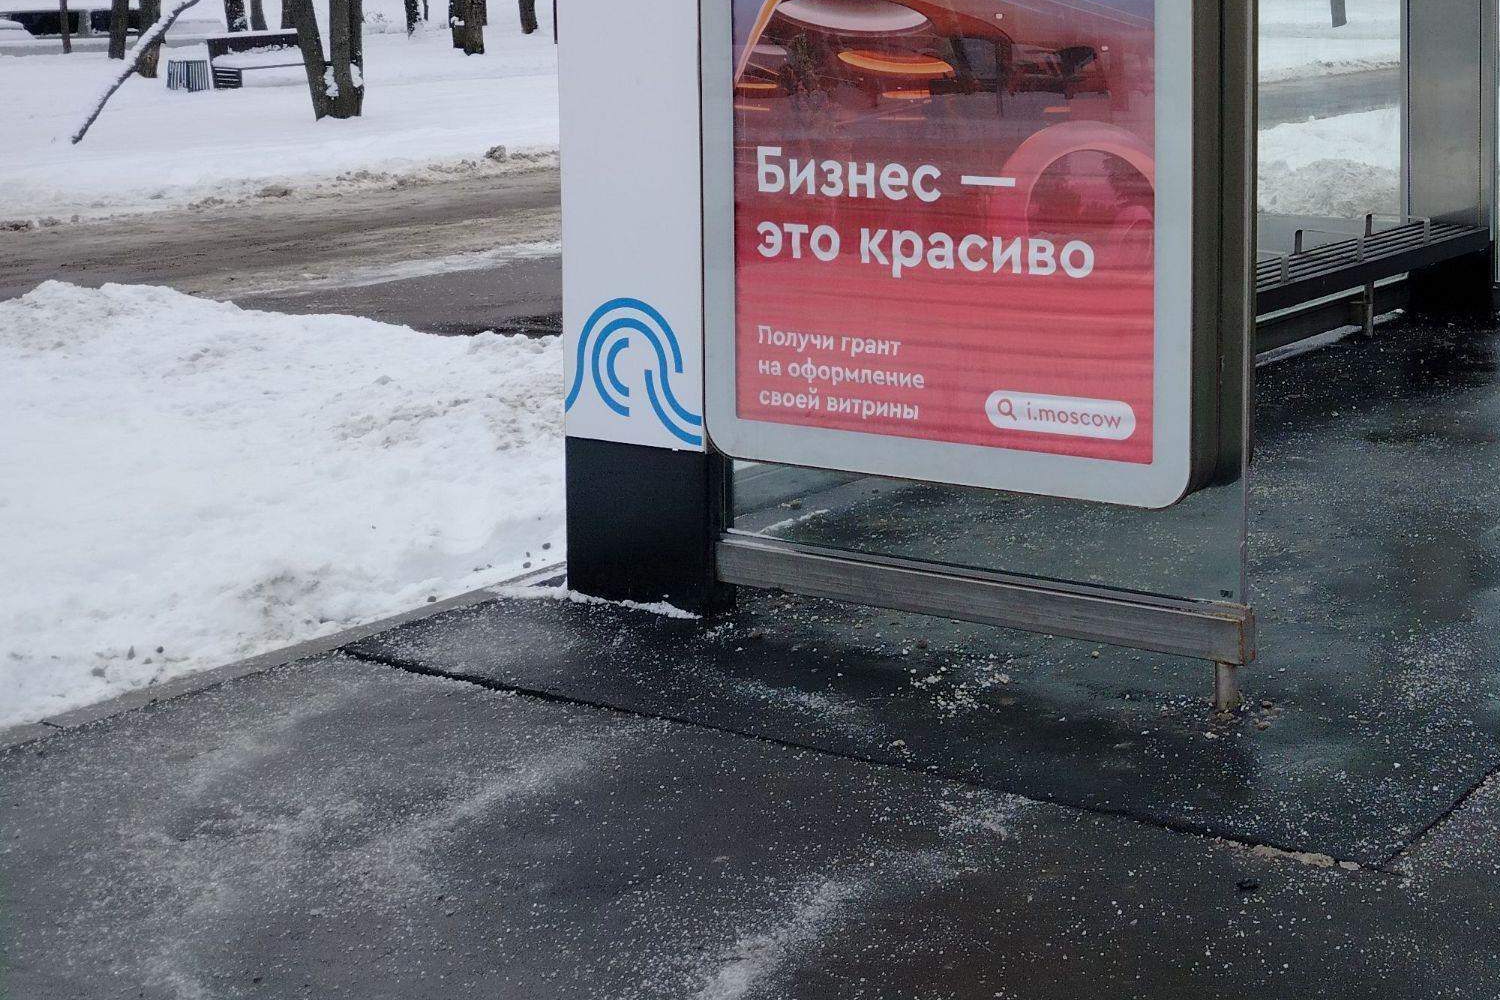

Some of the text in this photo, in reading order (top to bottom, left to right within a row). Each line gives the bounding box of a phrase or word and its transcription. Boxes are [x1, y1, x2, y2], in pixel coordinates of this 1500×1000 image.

[757, 146, 942, 202] Бизнес
[757, 221, 1095, 279] это красиво
[758, 325, 901, 357] Получи грант
[758, 357, 925, 389] на оформление
[759, 387, 919, 420] своей витрины
[1027, 401, 1121, 429] i.moscow
